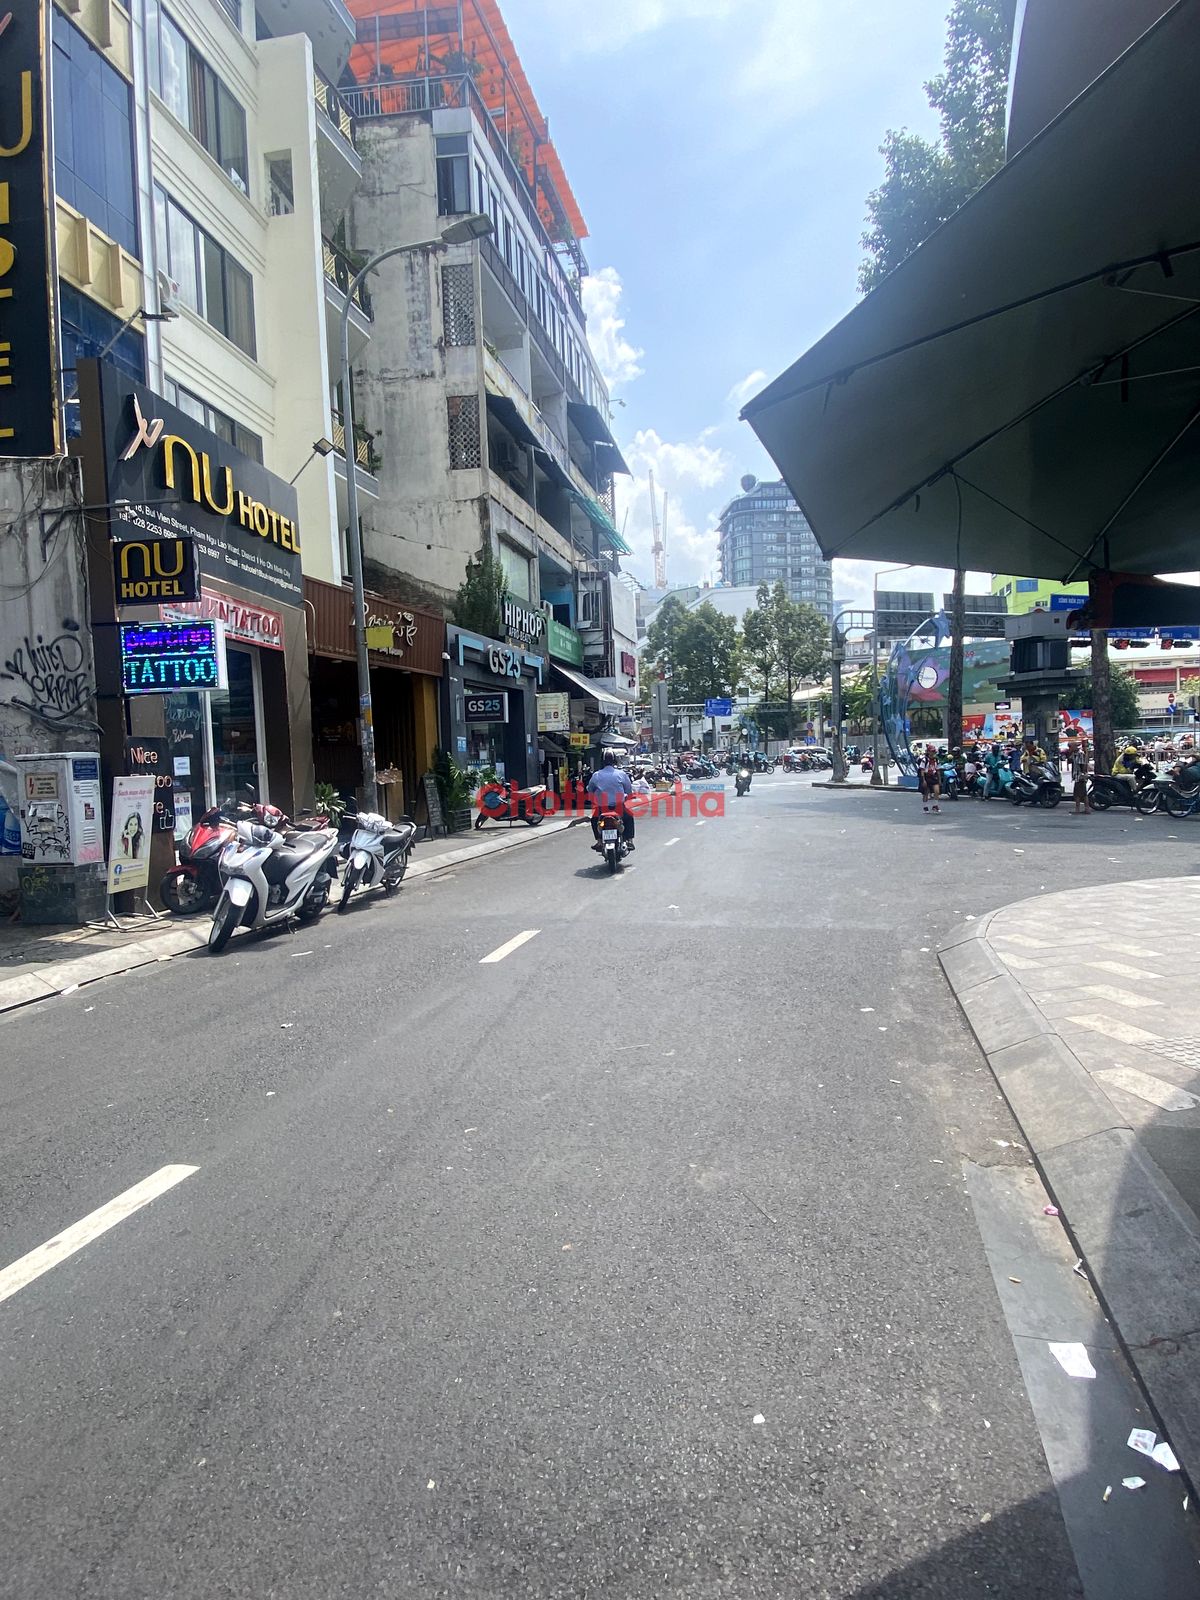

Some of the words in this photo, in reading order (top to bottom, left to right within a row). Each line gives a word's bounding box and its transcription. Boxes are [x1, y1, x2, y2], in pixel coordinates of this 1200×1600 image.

[236, 490, 301, 555] HOTEL
[206, 533, 217, 546] Ngu
[217, 539, 227, 549] Lao
[121, 580, 185, 599] HOTEL
[230, 606, 280, 637] TATTOO
[504, 601, 542, 637] HIPHOP
[125, 658, 215, 683] TATTOO
[488, 646, 521, 679] GS25
[468, 699, 500, 712] GS25
[130, 746, 158, 764] Nice
